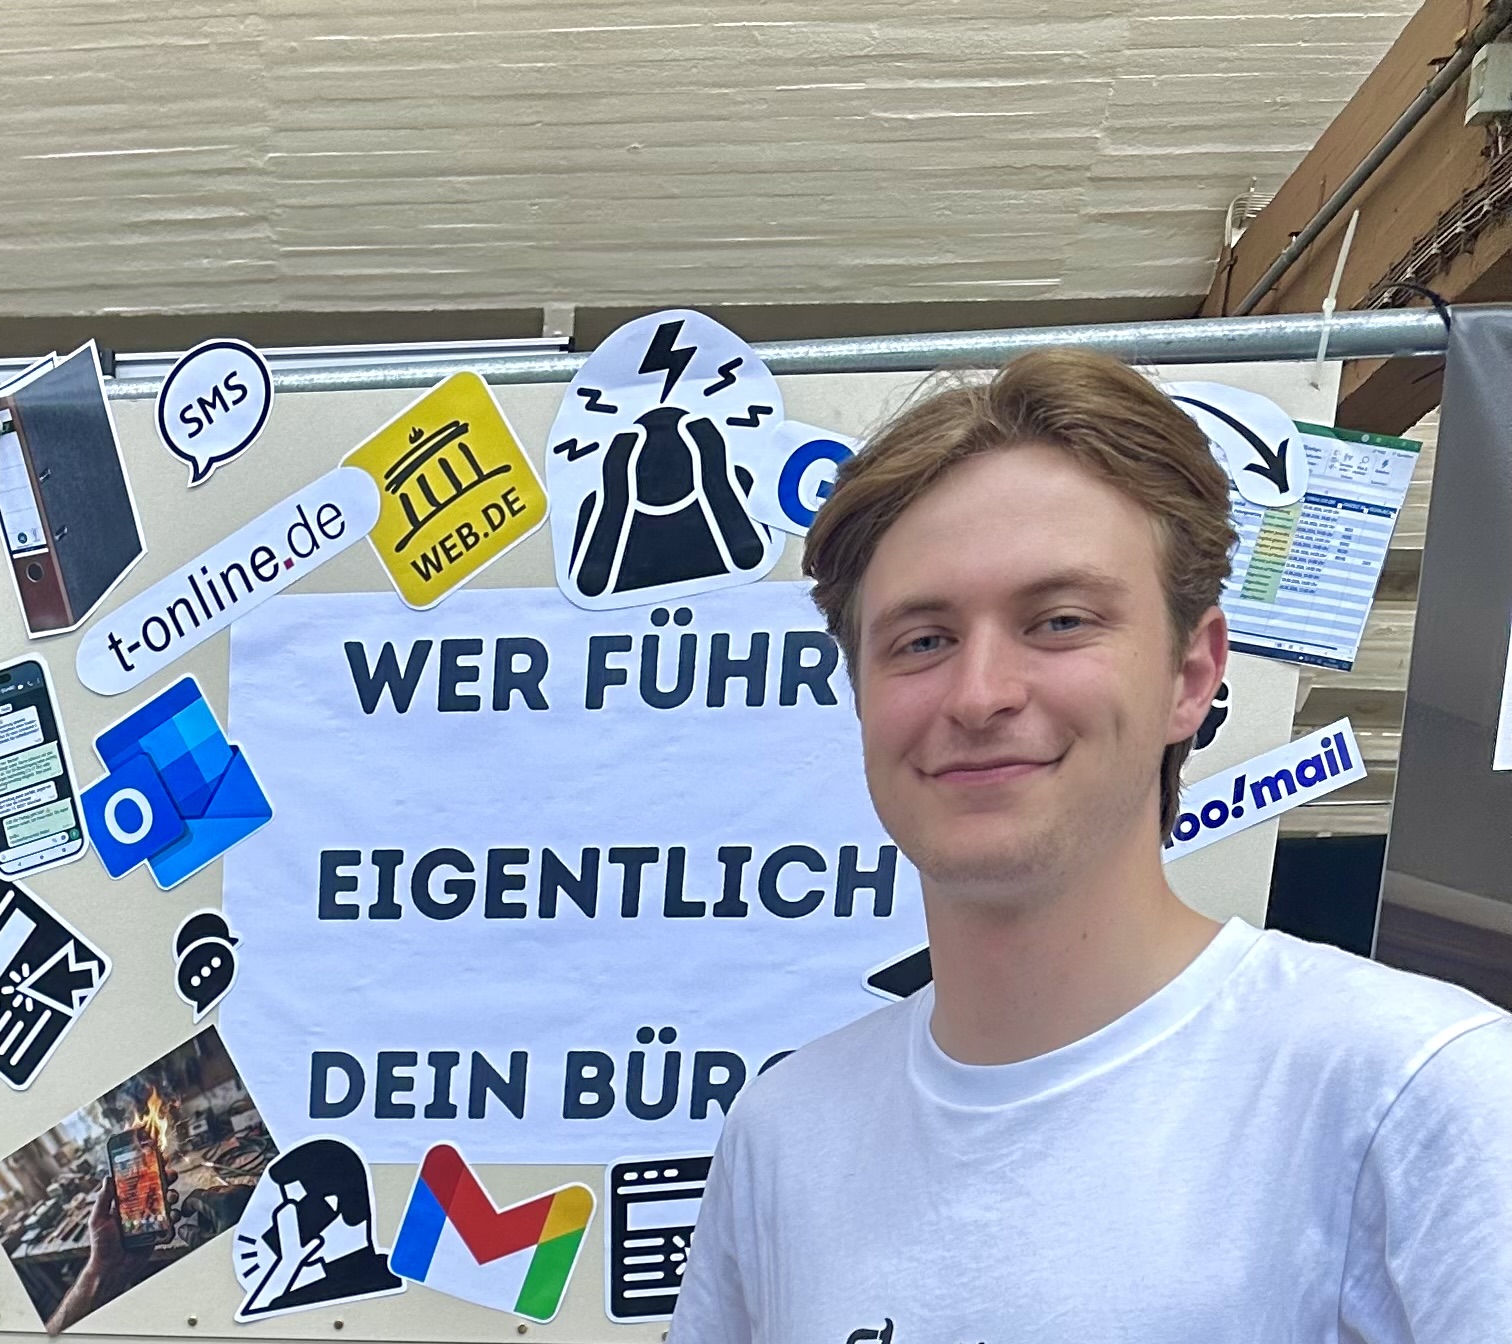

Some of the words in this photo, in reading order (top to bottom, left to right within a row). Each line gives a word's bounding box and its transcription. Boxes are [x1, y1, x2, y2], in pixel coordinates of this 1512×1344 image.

[178, 371, 249, 438] SMS
[410, 486, 528, 583] WEB.DE
[107, 497, 346, 673] t-online.de
[344, 638, 549, 714] WER
[585, 607, 840, 710] FÜHR
[318, 845, 898, 920] EIGENTLICH
[309, 1050, 528, 1119] DEIN
[562, 1026, 797, 1121] BÜR
